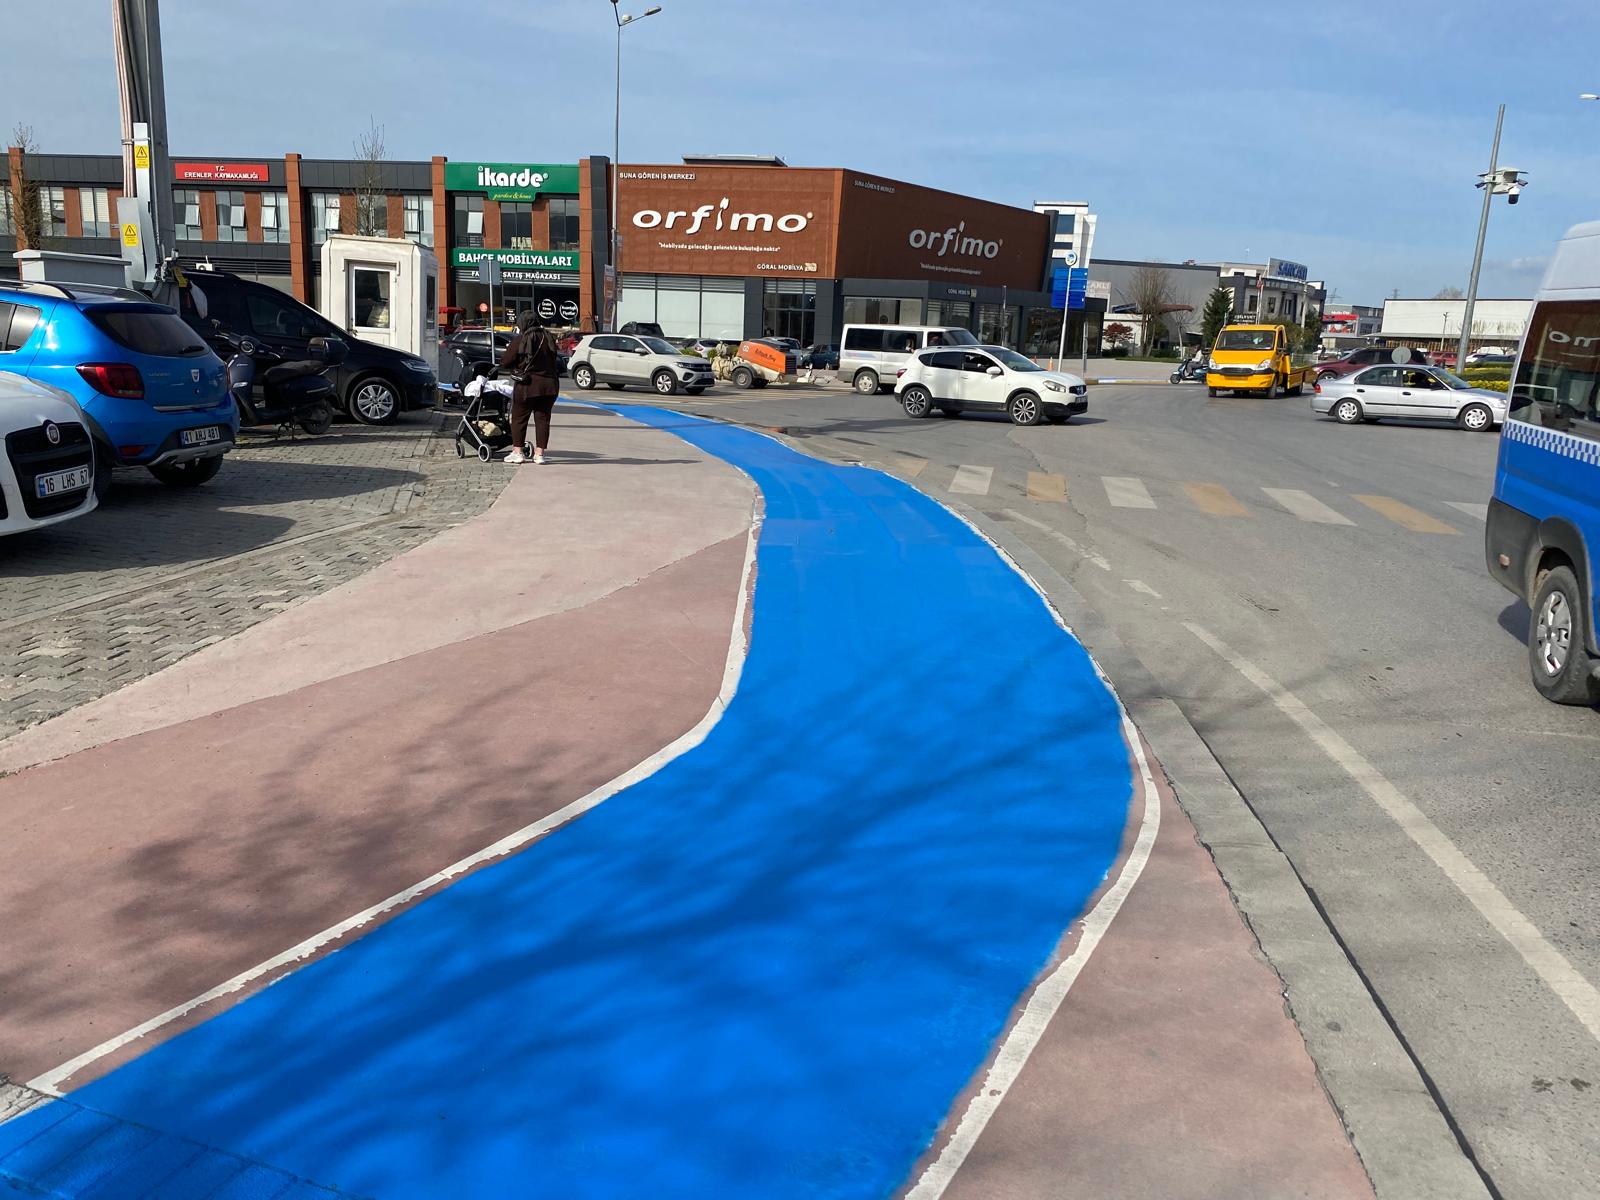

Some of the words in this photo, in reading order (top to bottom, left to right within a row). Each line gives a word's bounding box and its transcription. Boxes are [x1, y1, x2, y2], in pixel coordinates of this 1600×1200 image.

[637, 171, 660, 180] GÖREN
[667, 172, 696, 180] MERKEZİ
[632, 196, 808, 235] orfimo
[908, 220, 999, 259] orfimo
[497, 252, 572, 266] MOBİLYALARI
[756, 262, 777, 270] GÖRAL
[777, 263, 804, 271] MOBİLYA
[502, 271, 523, 280] SATIŞ
[525, 271, 561, 280] MAĞAZASI
[45, 478, 55, 493] 16
[61, 473, 76, 490] LHS
[80, 469, 88, 485] 67
